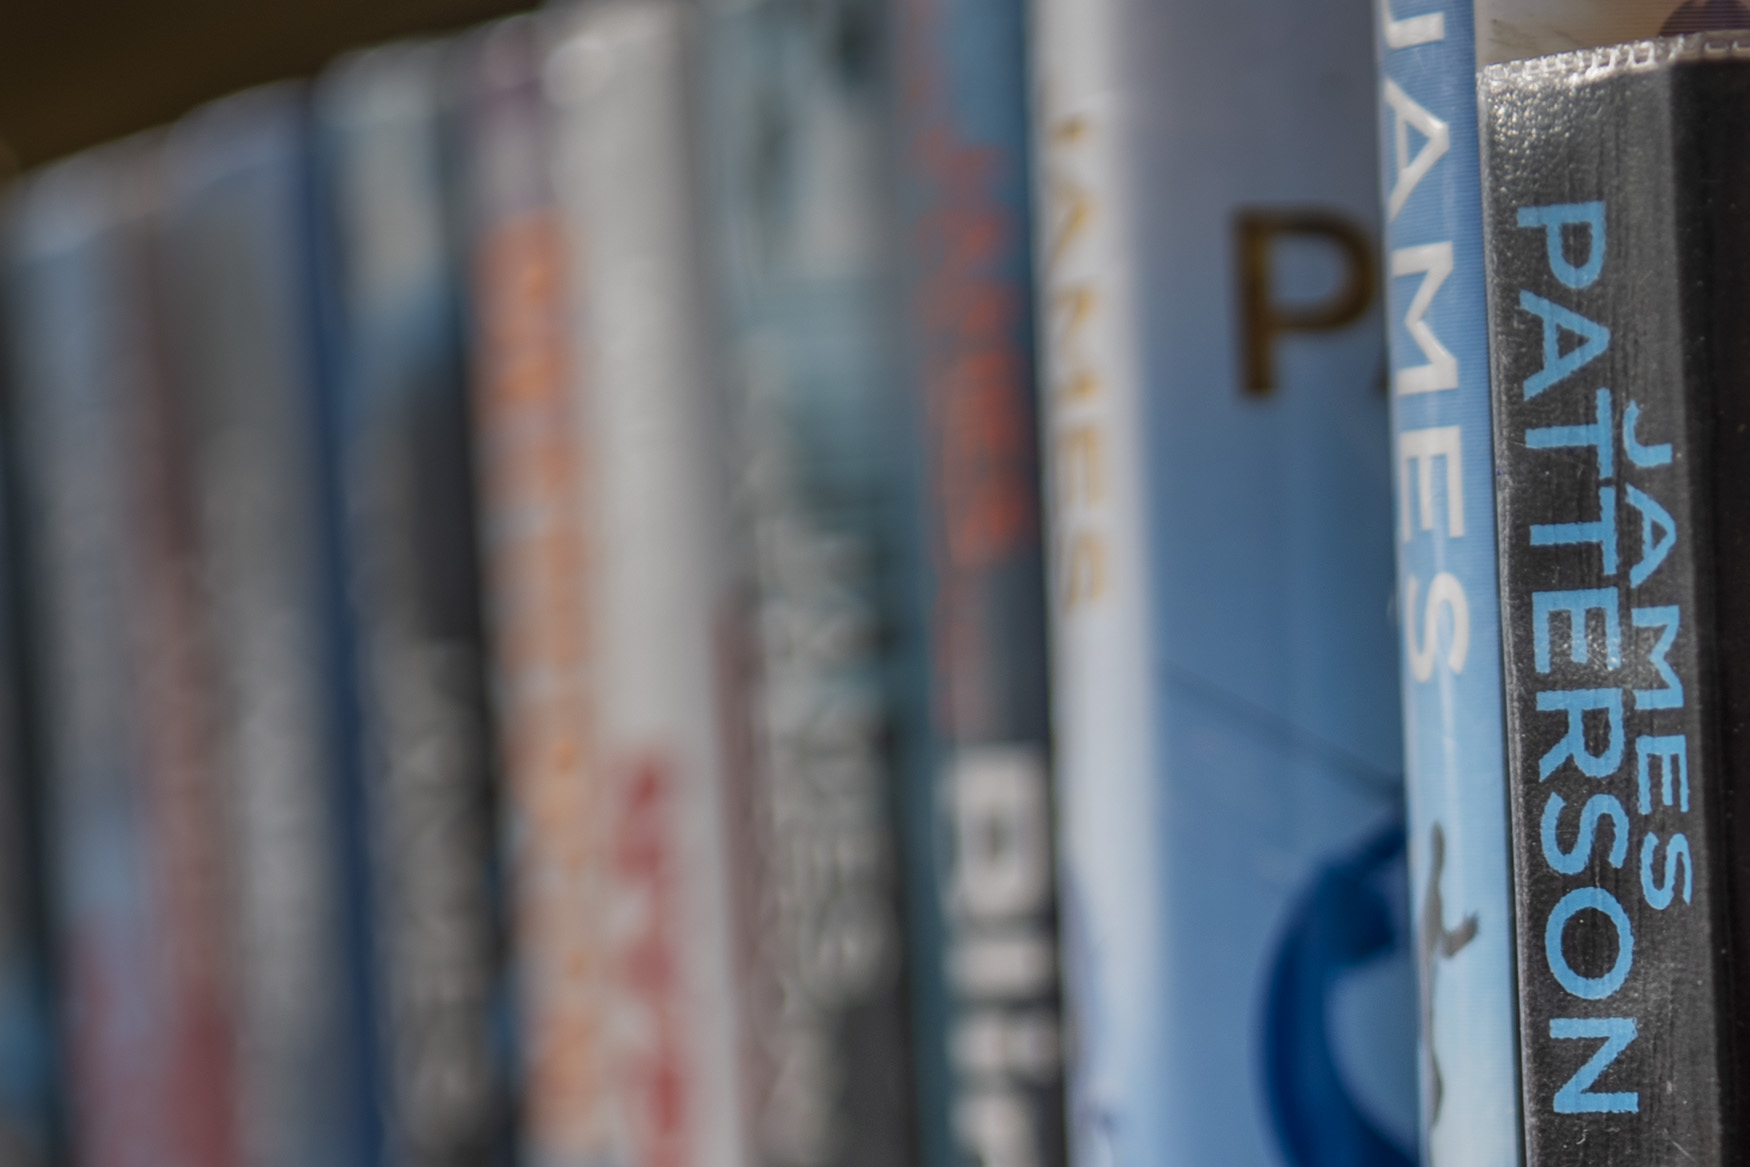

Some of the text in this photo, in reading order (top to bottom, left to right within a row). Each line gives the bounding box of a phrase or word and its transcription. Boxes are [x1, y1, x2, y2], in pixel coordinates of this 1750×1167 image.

[1045, 100, 1112, 616] JAMES
[1388, 0, 1471, 684] JAMES
[1516, 200, 1640, 1114] PATTERSON
[1621, 399, 1693, 911] JAMES
